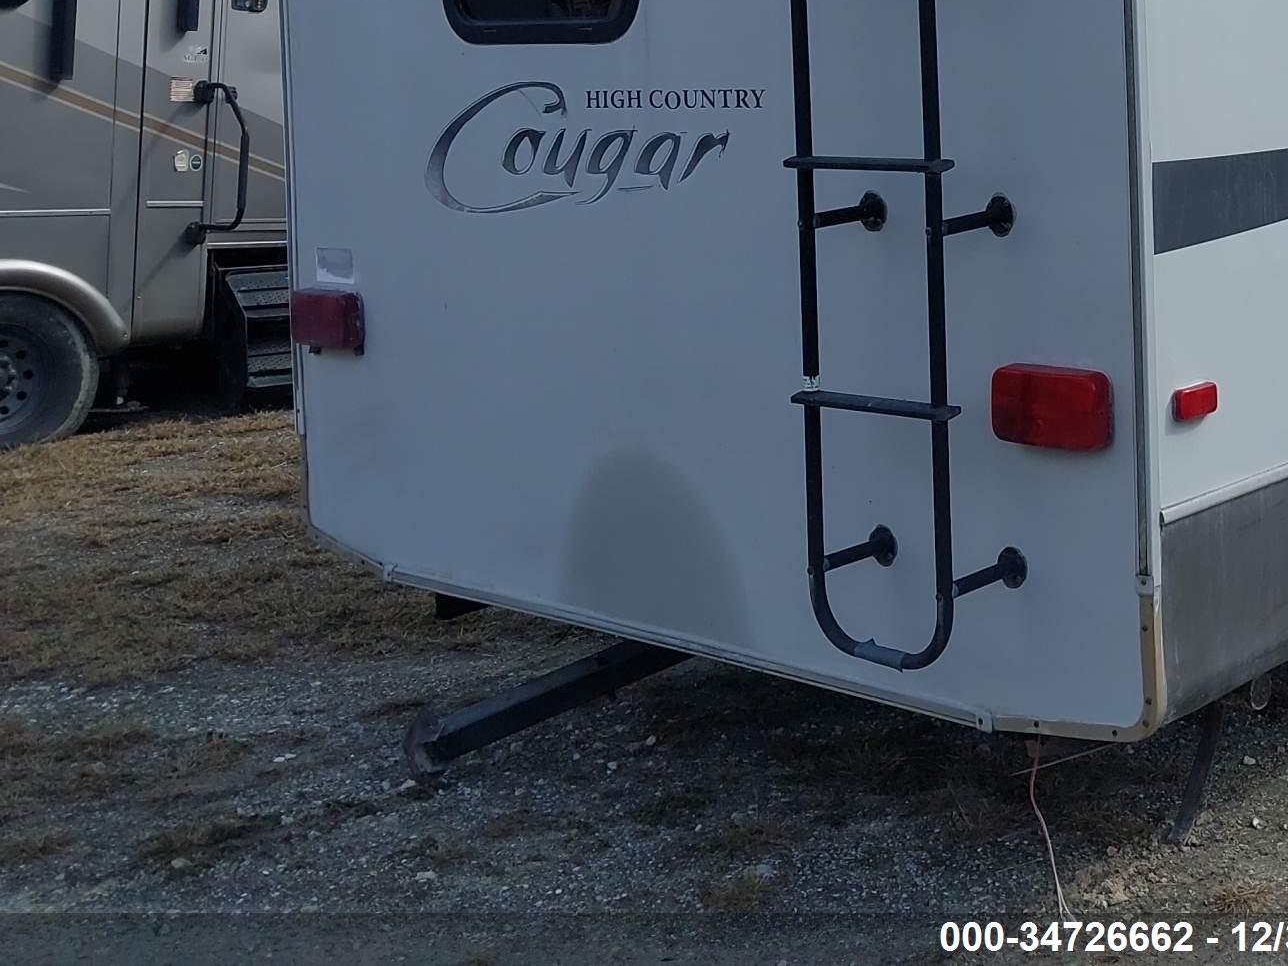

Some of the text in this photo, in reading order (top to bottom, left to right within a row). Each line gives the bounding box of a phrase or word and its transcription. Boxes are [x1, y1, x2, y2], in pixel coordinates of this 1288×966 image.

[585, 89, 766, 110] HIGH COUNTRY
[425, 81, 730, 214] Cougar
